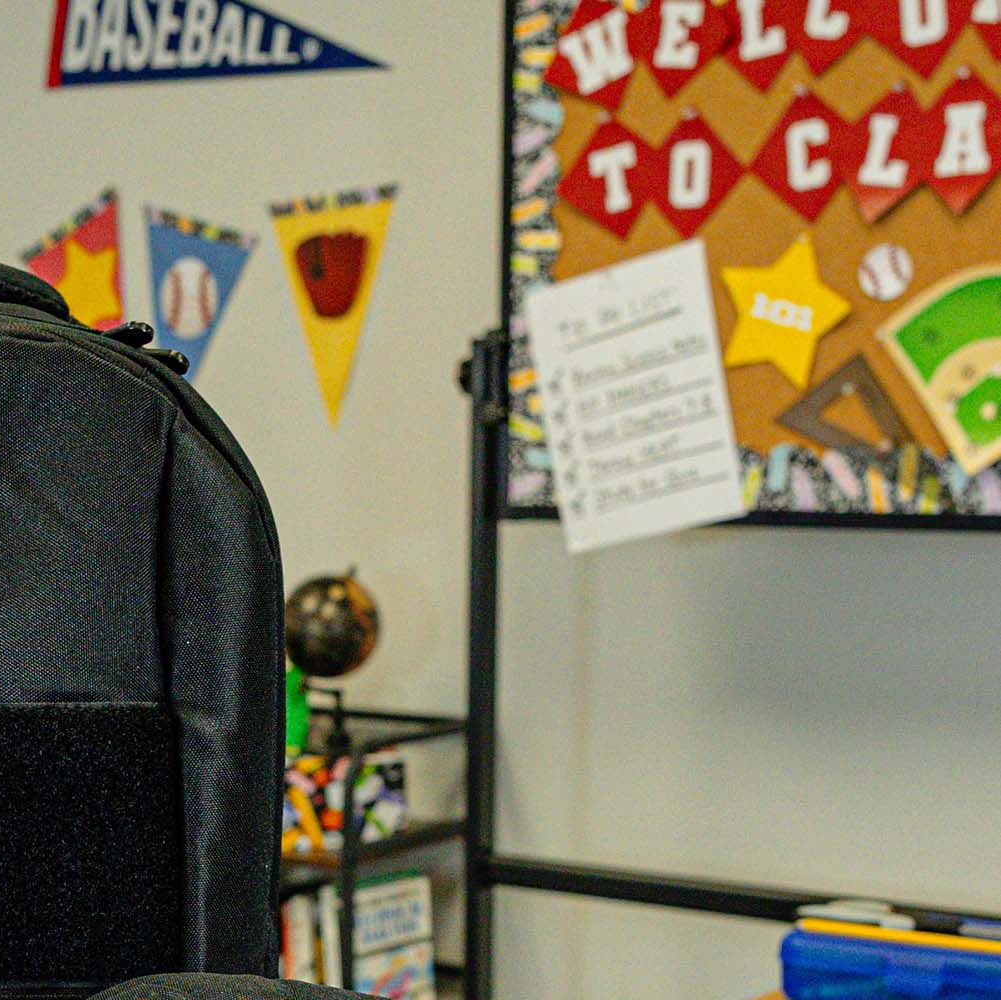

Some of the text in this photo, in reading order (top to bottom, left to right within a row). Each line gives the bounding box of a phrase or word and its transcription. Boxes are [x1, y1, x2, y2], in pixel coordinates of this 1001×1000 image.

[61, 0, 300, 73] BASEBALL
[559, 0, 1001, 95] WELCO
[588, 100, 992, 215] TO CLA
